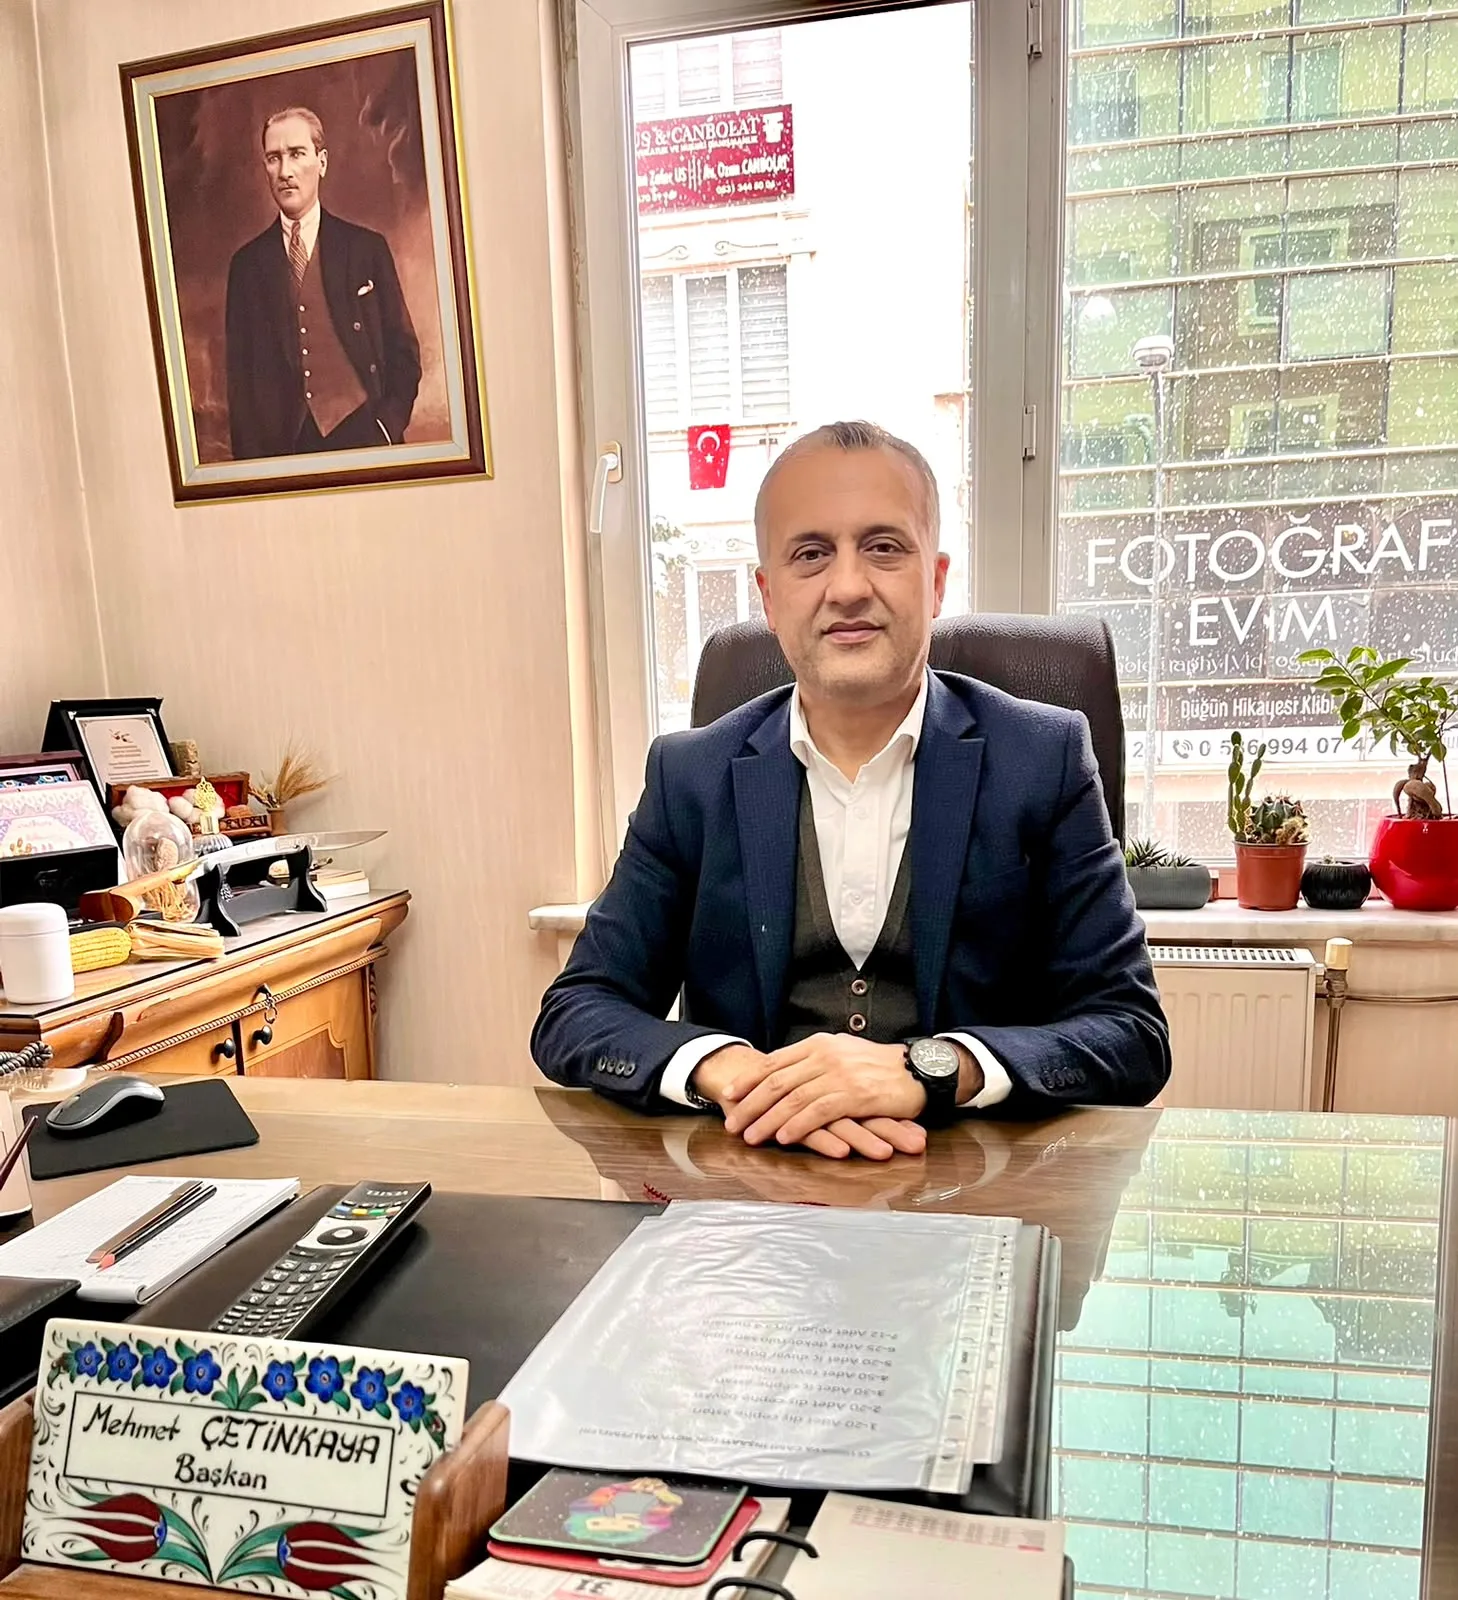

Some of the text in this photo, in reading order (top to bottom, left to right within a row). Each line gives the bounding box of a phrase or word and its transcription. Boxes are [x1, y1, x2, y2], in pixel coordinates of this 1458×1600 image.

[671, 119, 758, 144] CANBOLAT
[1087, 516, 1452, 588] FOTOĞRAF
[1267, 737, 1308, 755] 994
[82, 1402, 382, 1466] Mehmet ÇETİNKAYA
[174, 1453, 268, 1491] Başkan
